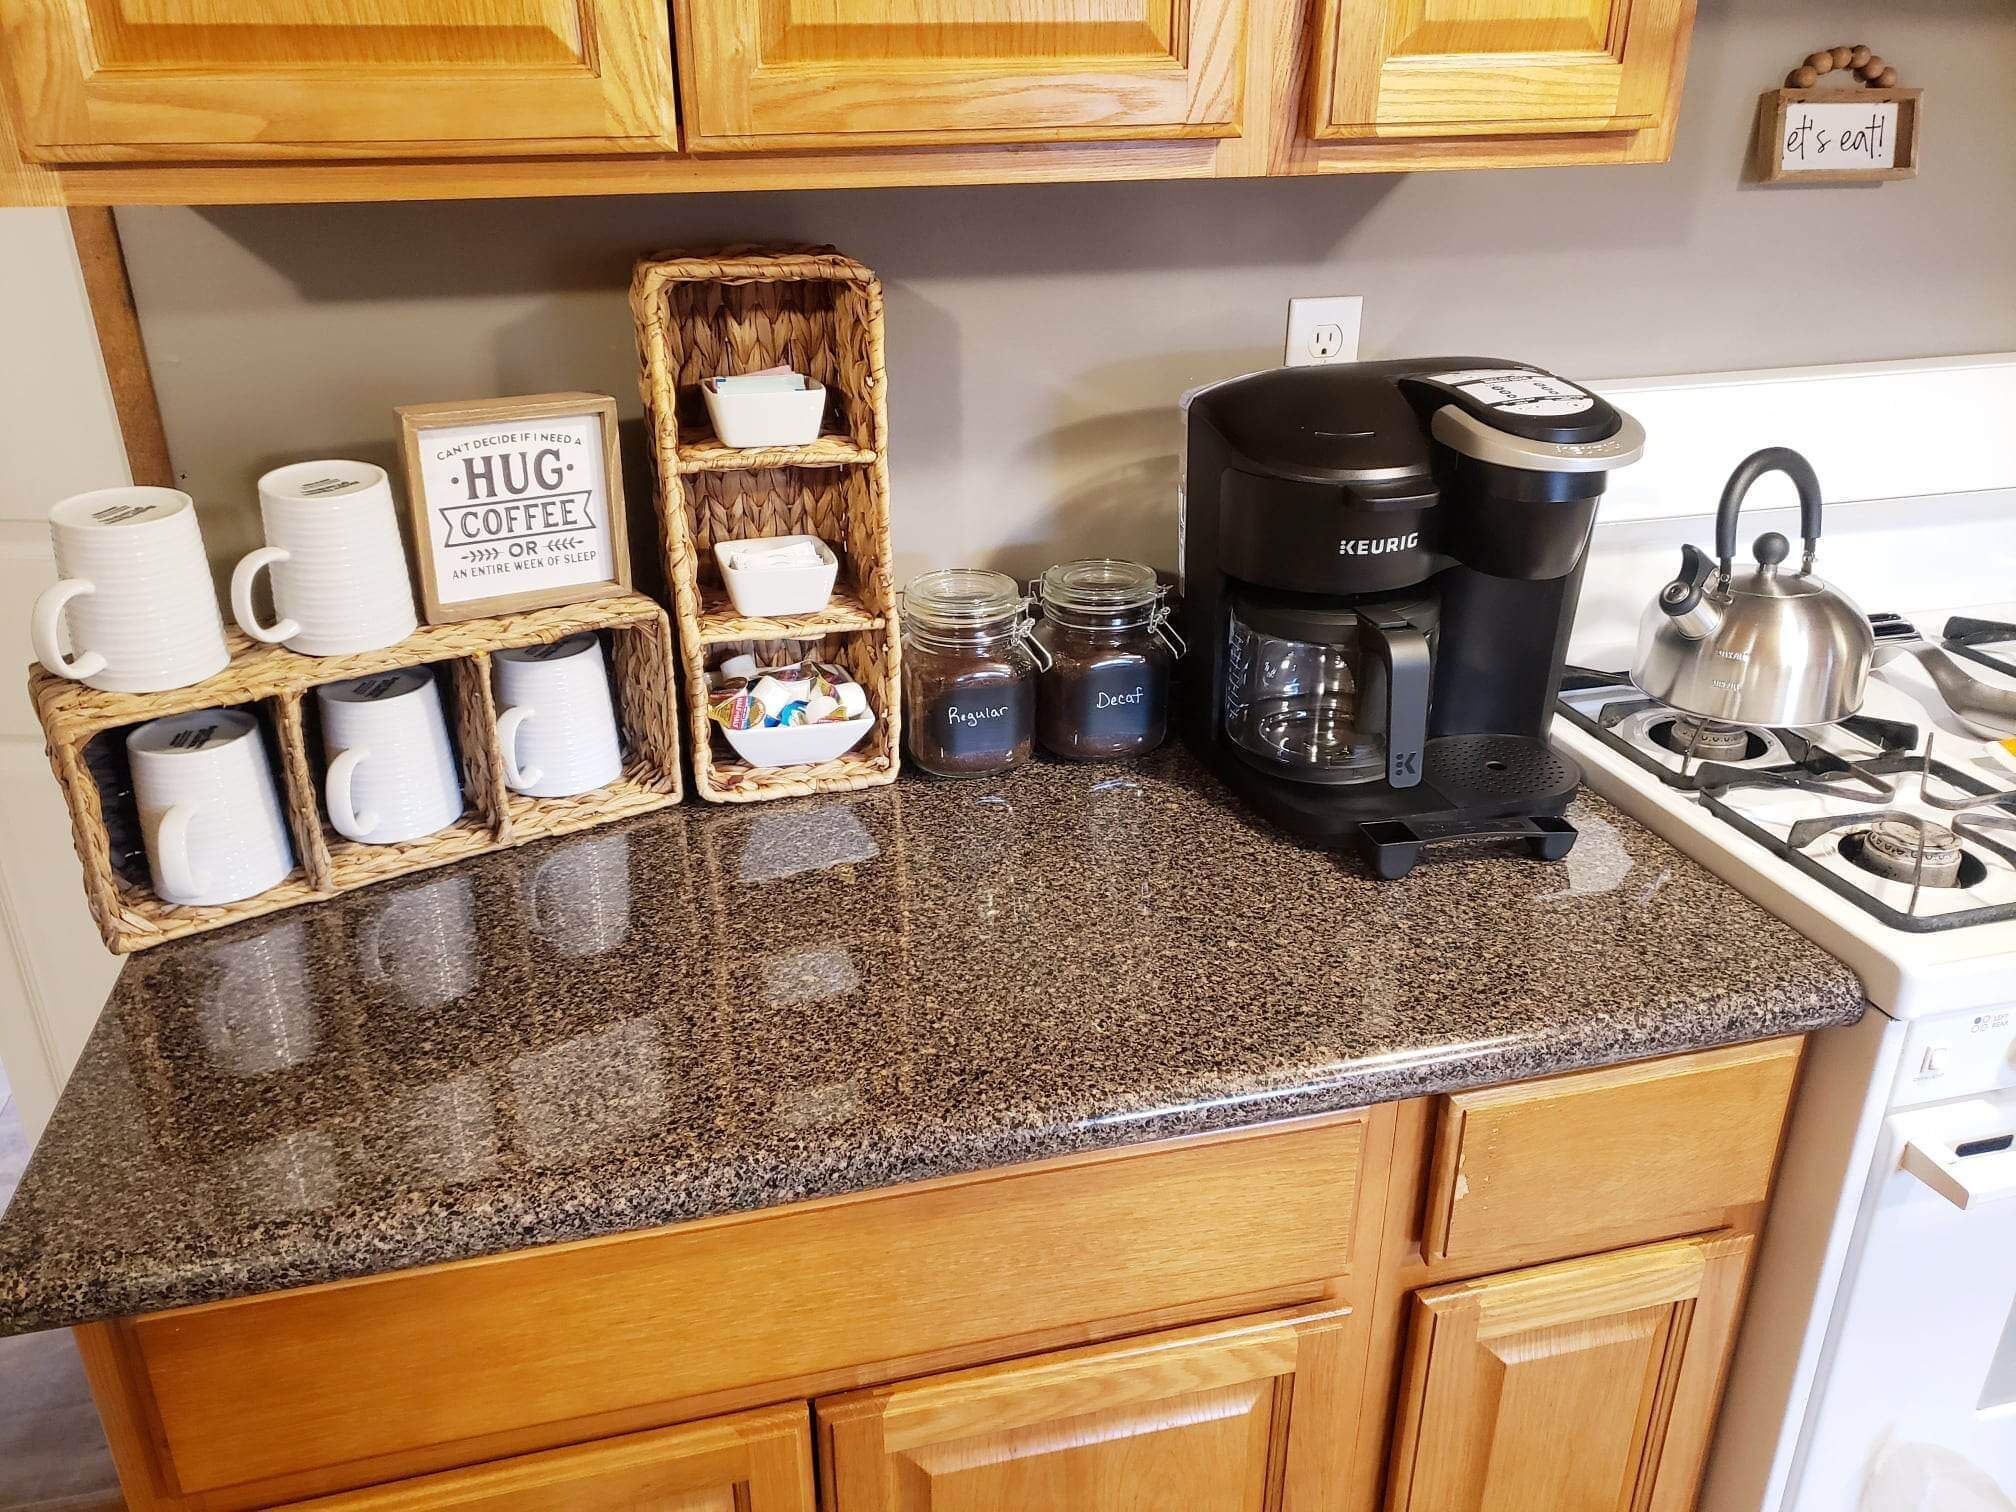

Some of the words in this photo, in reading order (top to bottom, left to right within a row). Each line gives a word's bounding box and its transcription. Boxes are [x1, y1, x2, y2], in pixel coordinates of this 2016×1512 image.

[1786, 114, 1832, 160] et's
[1840, 114, 1885, 160] eat!
[437, 442, 471, 461] CAN'T
[473, 433, 518, 449] DECIDE
[520, 433, 531, 443] IF
[540, 433, 572, 444] NEED
[574, 438, 582, 446] A
[462, 448, 564, 500] HUG
[460, 499, 578, 538] COFFEE
[508, 540, 538, 558] OR
[1339, 532, 1419, 555] KEURIG
[452, 568, 468, 580] AN
[471, 562, 511, 577] ENTIRE
[514, 558, 544, 571] WEEK
[547, 555, 562, 566] OF
[564, 551, 597, 564] SLEEP
[1096, 686, 1145, 709] Decaf
[948, 706, 1009, 728] Regular
